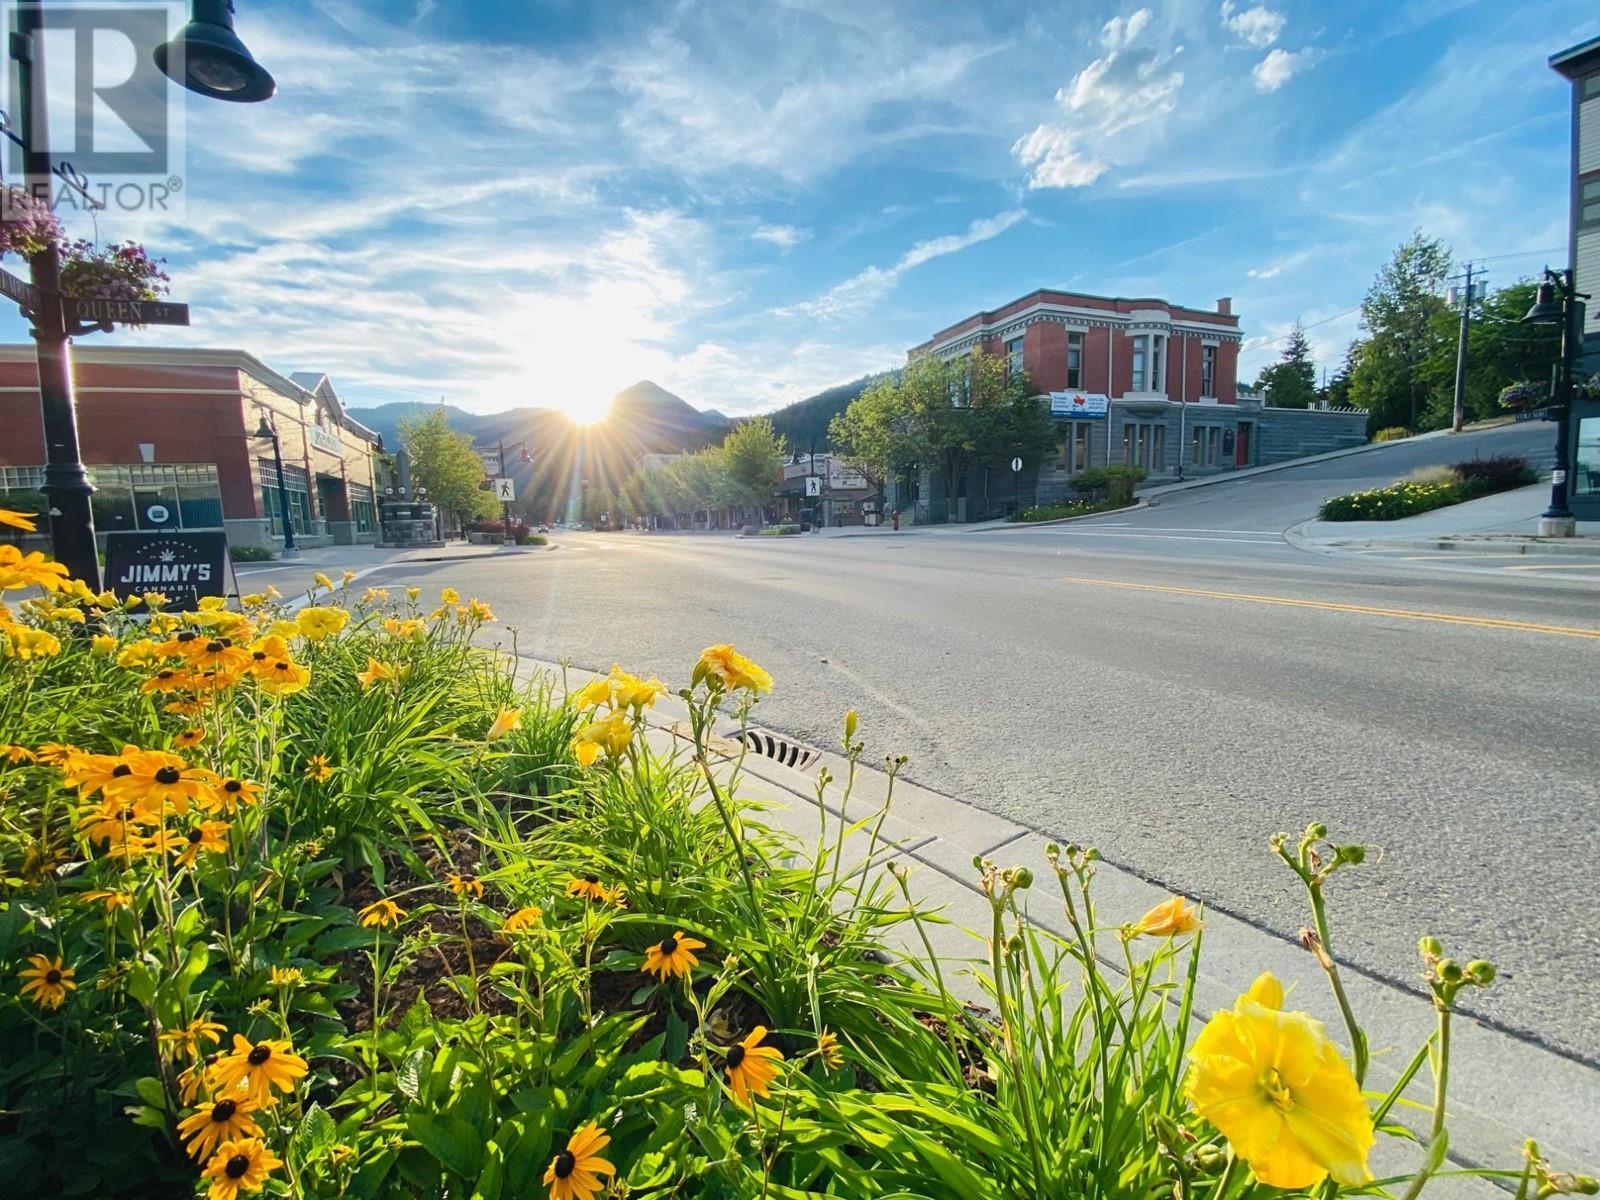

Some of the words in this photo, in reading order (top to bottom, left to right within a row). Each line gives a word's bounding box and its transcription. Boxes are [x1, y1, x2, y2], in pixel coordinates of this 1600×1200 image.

[76, 301, 143, 319] QUEEN
[155, 308, 170, 317] ST
[121, 563, 211, 583] JIMMY'S
[135, 584, 196, 593] CANNABIS
